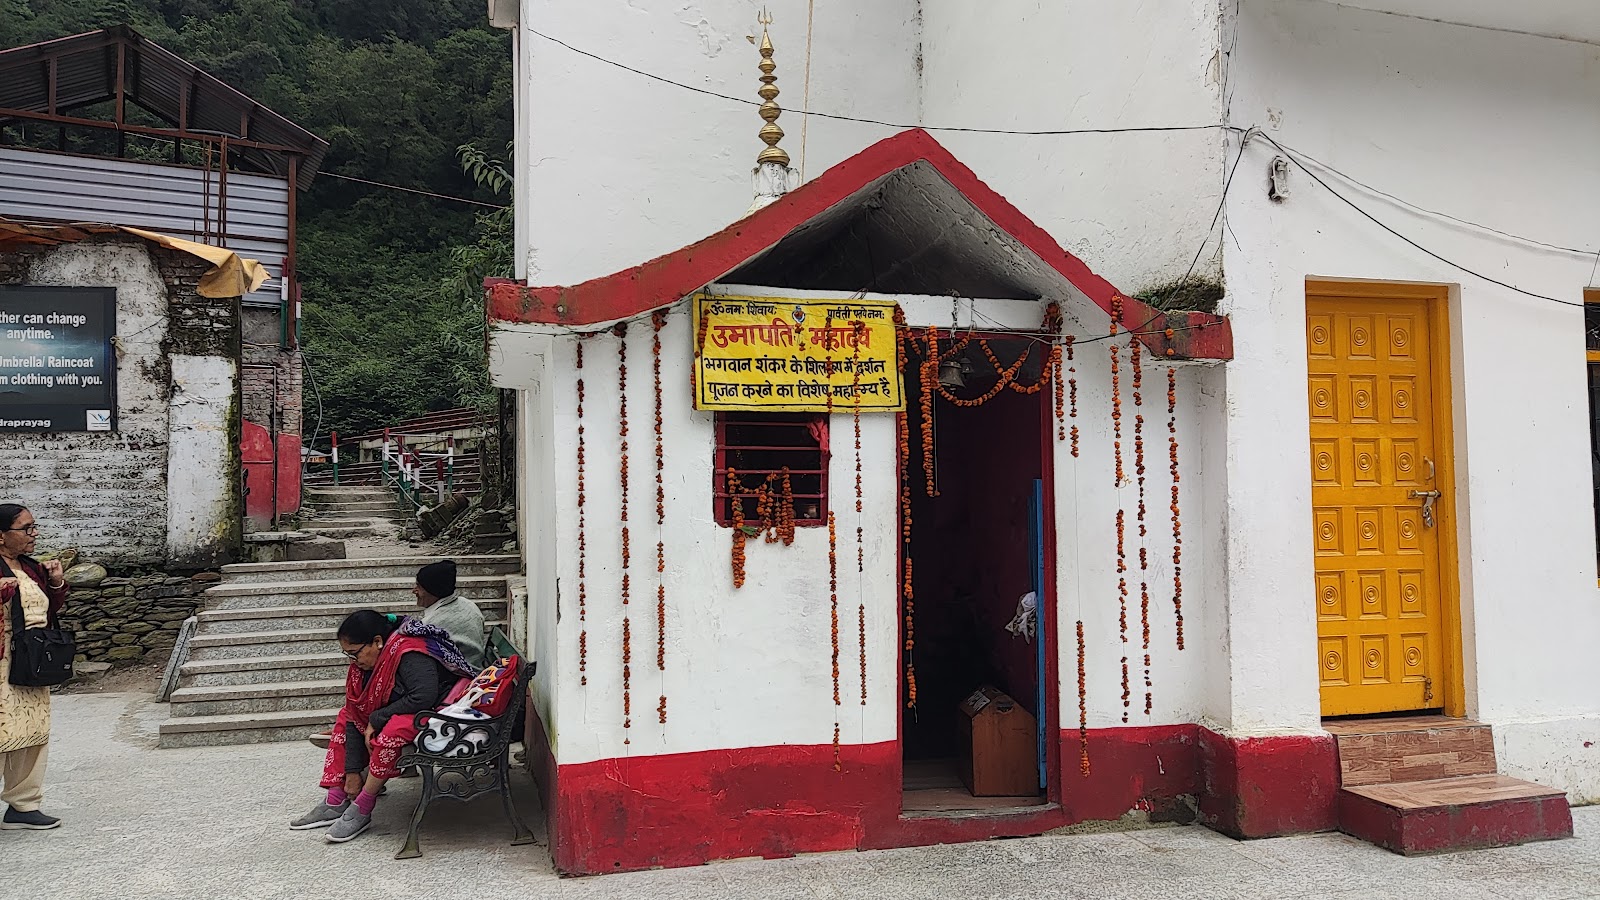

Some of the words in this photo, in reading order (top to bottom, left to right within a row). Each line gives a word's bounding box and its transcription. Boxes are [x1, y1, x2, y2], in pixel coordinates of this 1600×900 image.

[23, 314, 44, 324] can
[46, 312, 87, 327] change
[7, 327, 55, 342] anytime.
[711, 317, 795, 348] उमापति
[48, 356, 94, 368] Raincoat
[703, 357, 752, 373] भगवान
[754, 355, 787, 374] शंकर
[789, 355, 804, 374] के
[843, 357, 855, 373] में
[856, 357, 886, 376] दर्शन
[11, 373, 54, 388] clothing
[56, 373, 79, 385] with
[81, 375, 103, 388] you.
[707, 381, 740, 402] पूजन
[741, 381, 773, 398] करने
[776, 383, 795, 397] का
[796, 379, 830, 399] विशेष
[879, 377, 891, 399] है
